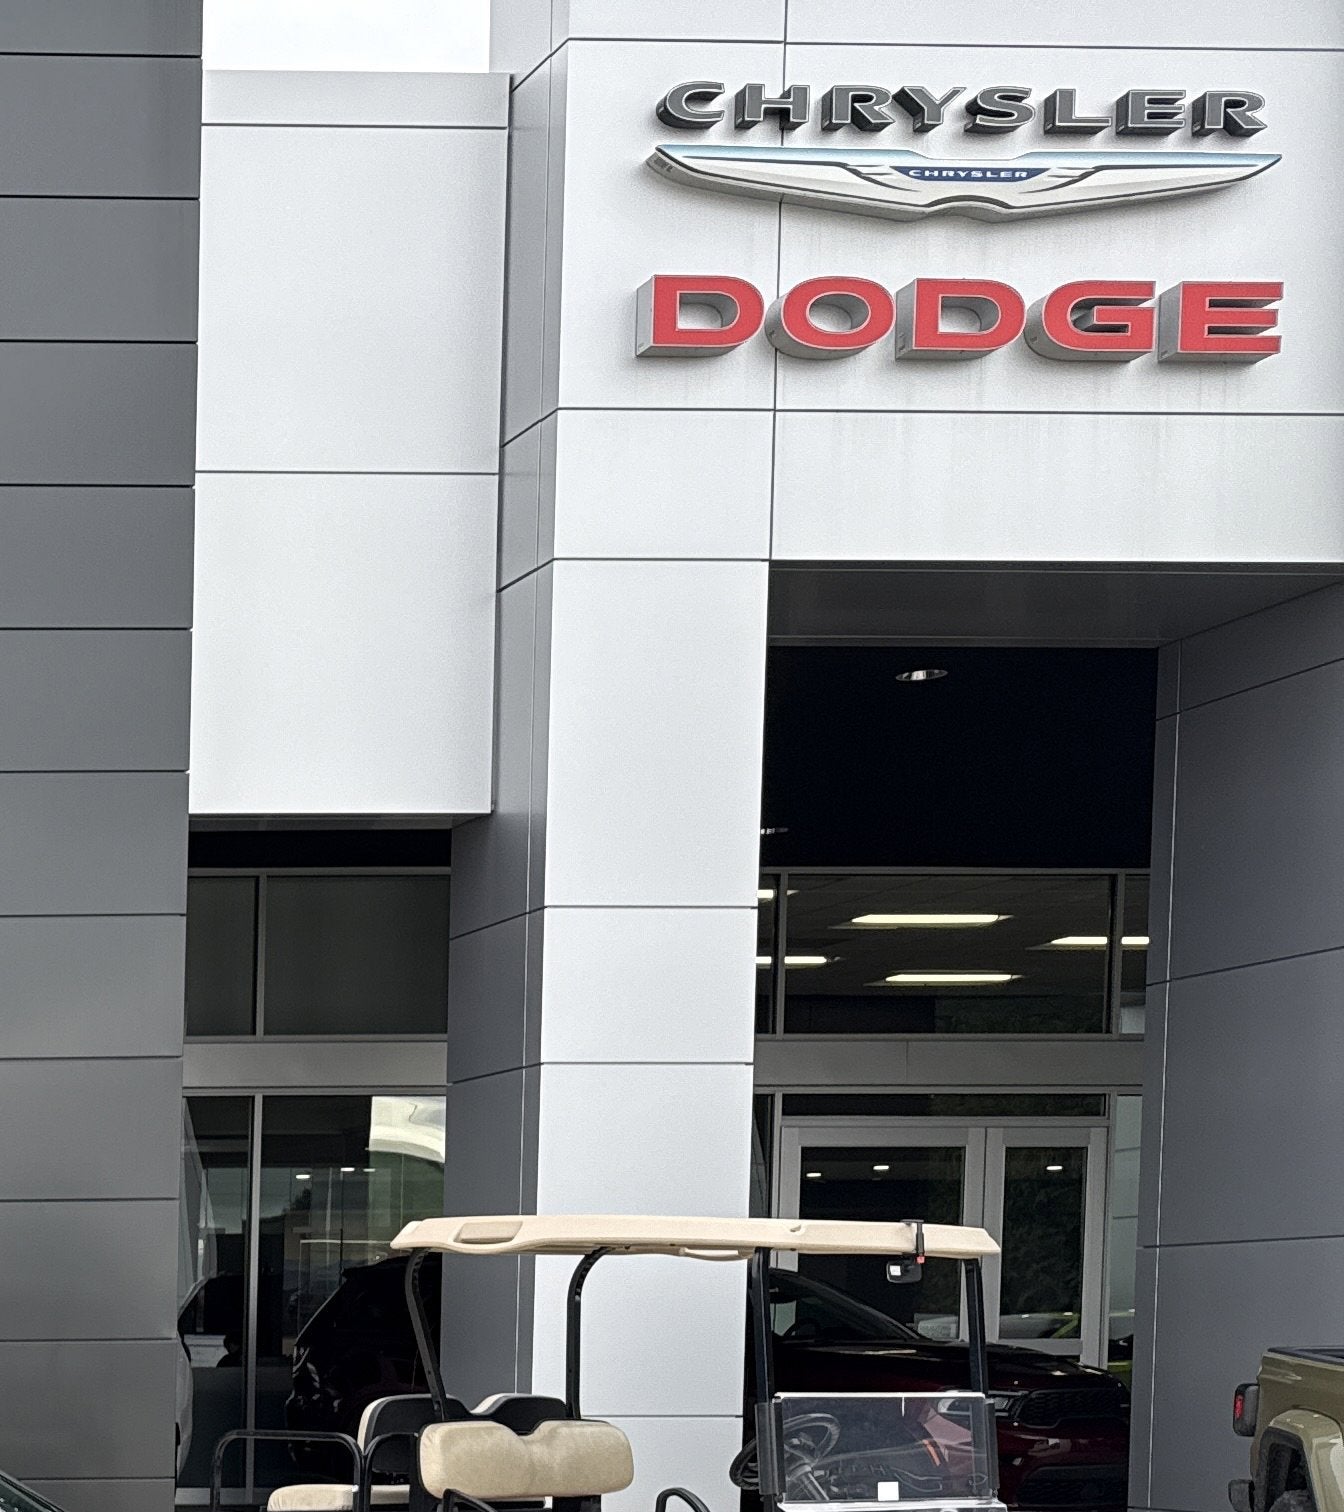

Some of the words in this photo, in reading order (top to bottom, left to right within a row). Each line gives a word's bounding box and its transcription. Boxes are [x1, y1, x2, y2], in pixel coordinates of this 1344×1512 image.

[656, 81, 1267, 136] CHRYSLER
[908, 168, 1028, 178] CHRYSLER
[635, 274, 1284, 362] DODGE
